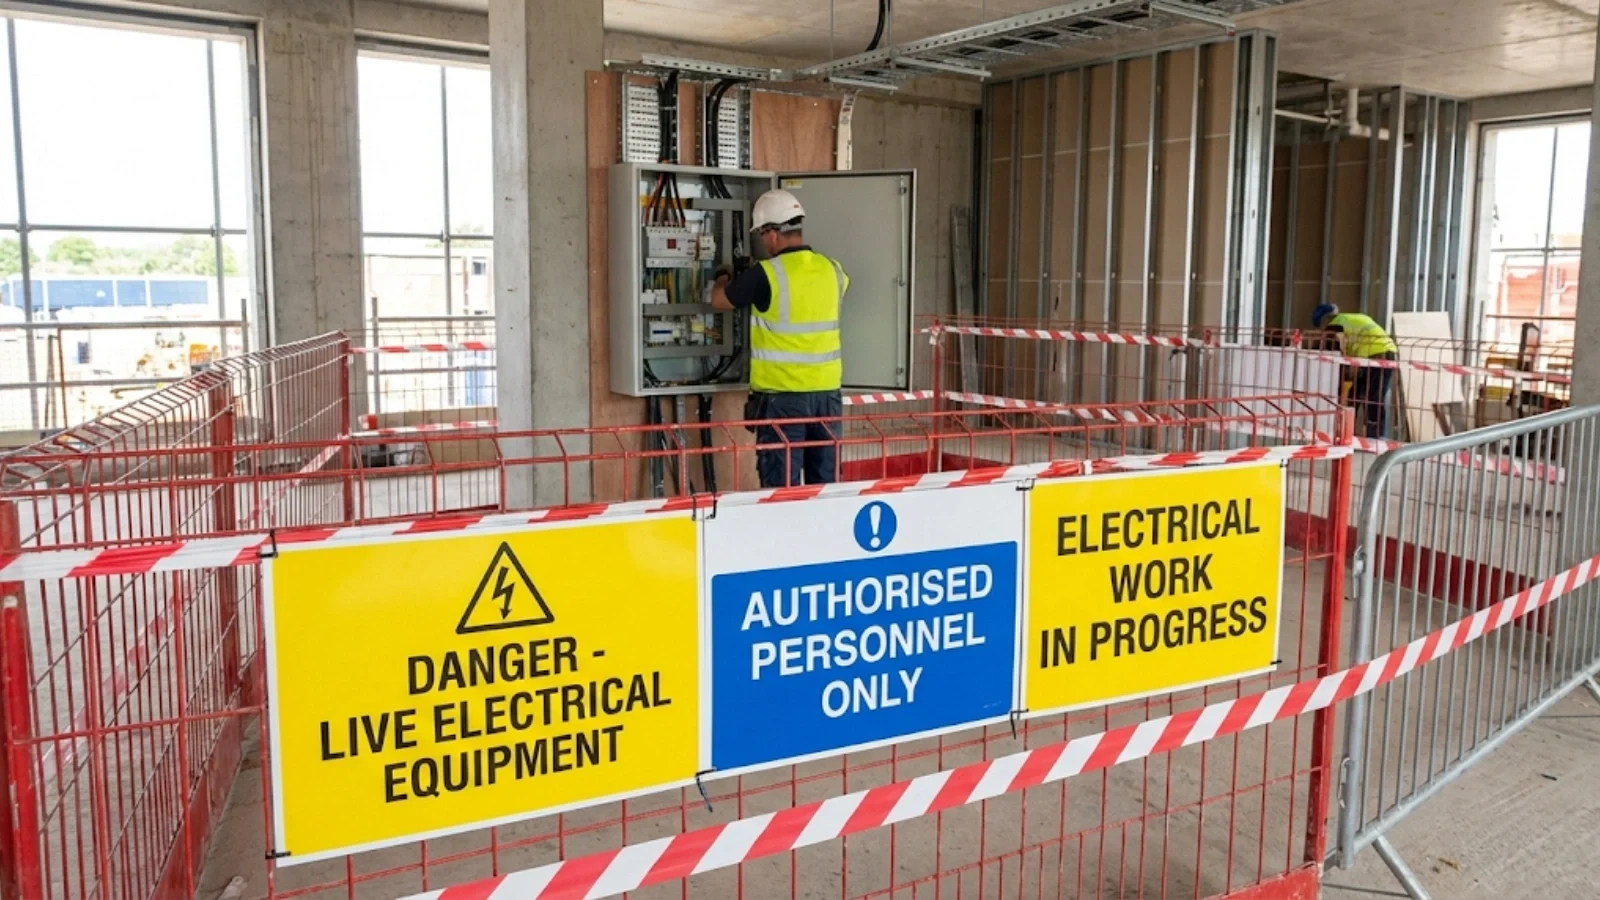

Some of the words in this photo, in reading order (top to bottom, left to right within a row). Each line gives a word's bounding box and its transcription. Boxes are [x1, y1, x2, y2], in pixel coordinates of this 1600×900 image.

[1057, 498, 1260, 557] ELECTRICAL
[741, 564, 993, 631] AUTHORISED
[1109, 553, 1213, 604] WORK
[407, 636, 578, 696] DANGER
[752, 612, 986, 680] PERSONNEL
[1040, 625, 1076, 669] IN
[1090, 596, 1267, 661] PROGRESS
[320, 708, 418, 761] LIVE
[433, 671, 672, 744] ELECTRICAL
[821, 667, 923, 718] ONLY
[384, 724, 624, 804] EQUIPMENT
